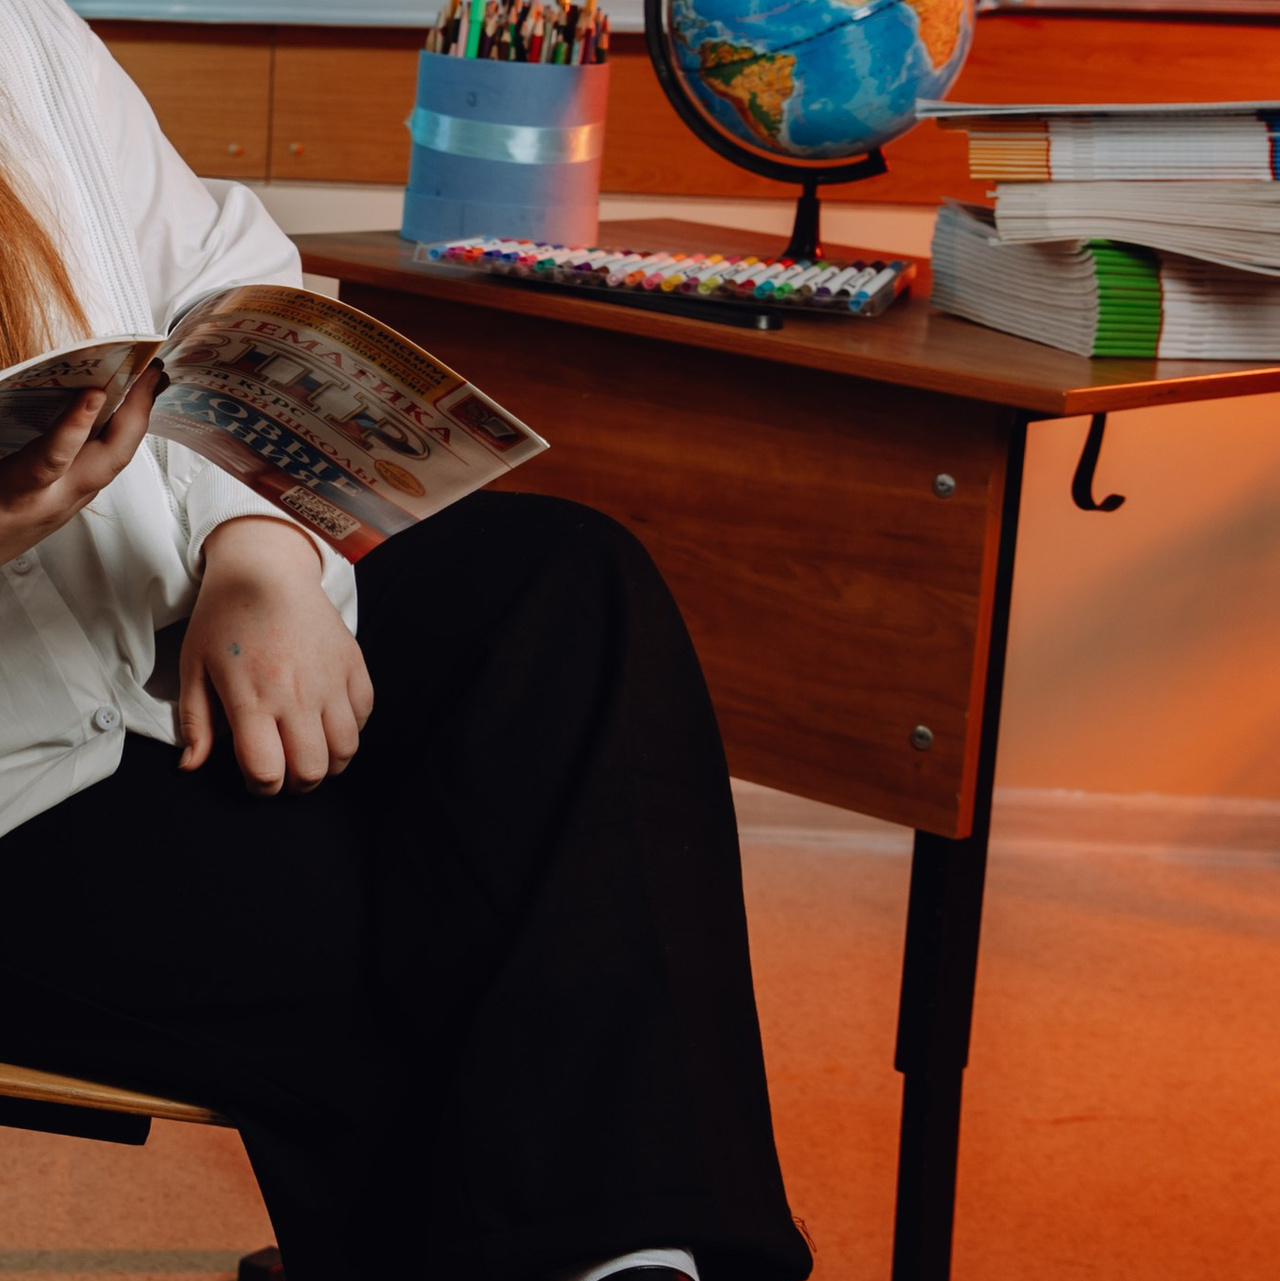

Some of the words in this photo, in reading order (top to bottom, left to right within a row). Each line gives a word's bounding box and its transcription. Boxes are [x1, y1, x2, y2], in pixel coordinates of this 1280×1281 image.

[376, 330, 448, 380] ИНСТИТУТ
[236, 375, 306, 419] курс
[273, 411, 380, 488] ШКОЛЫ
